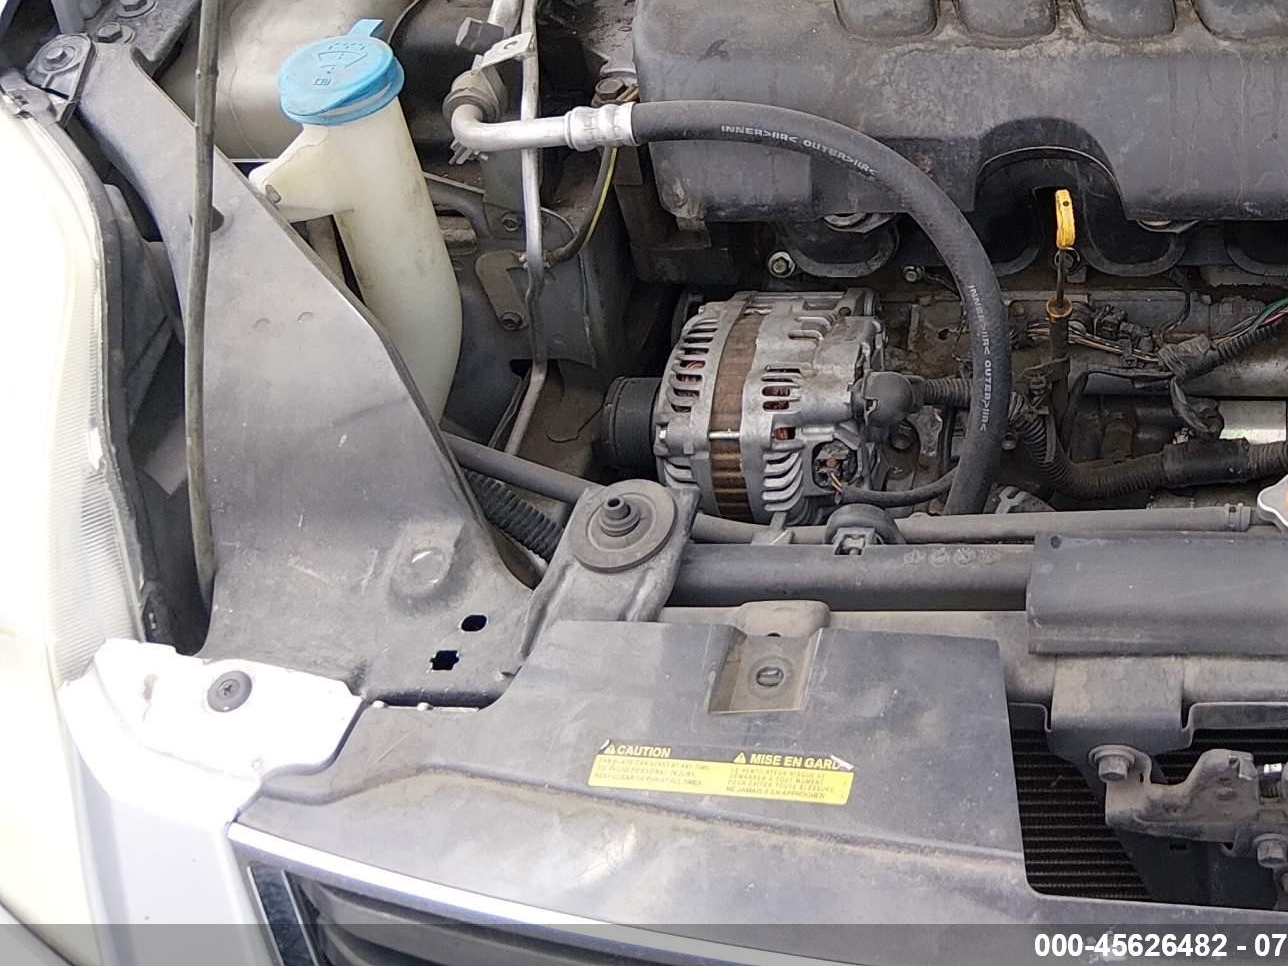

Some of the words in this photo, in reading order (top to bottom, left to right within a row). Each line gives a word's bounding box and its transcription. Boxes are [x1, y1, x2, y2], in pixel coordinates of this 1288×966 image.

[616, 744, 671, 758] CAUTION
[749, 753, 782, 766] MISE
[783, 756, 801, 768] EN
